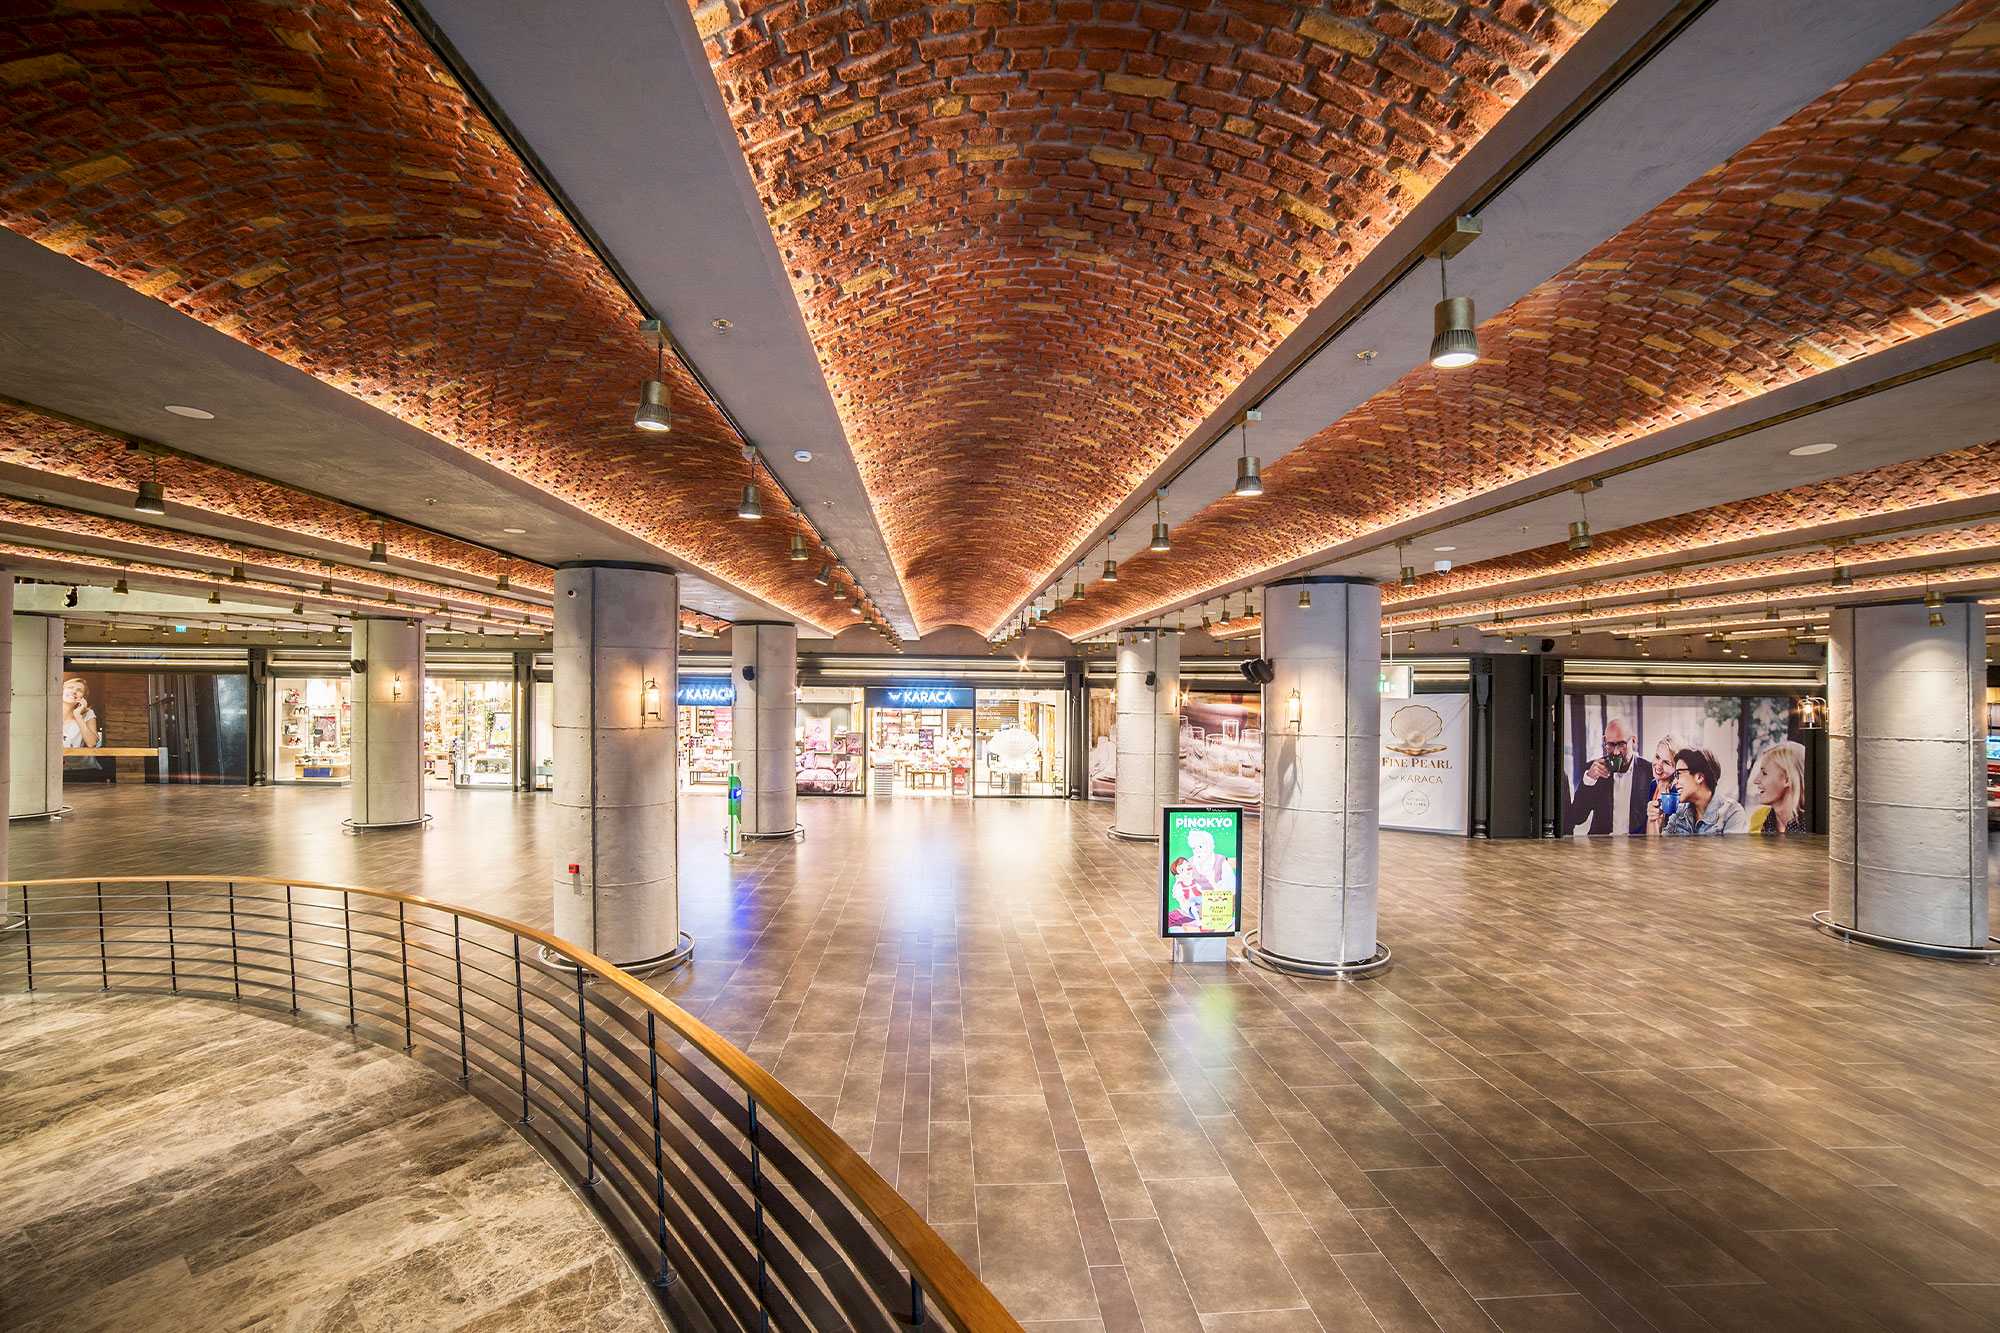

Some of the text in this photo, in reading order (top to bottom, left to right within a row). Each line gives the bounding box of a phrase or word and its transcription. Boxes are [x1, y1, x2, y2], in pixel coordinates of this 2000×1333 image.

[687, 688, 732, 699] KARAC
[904, 691, 954, 703] KARACA
[1382, 757, 1453, 769] FINE PEARL
[1400, 775, 1443, 785] KARACA
